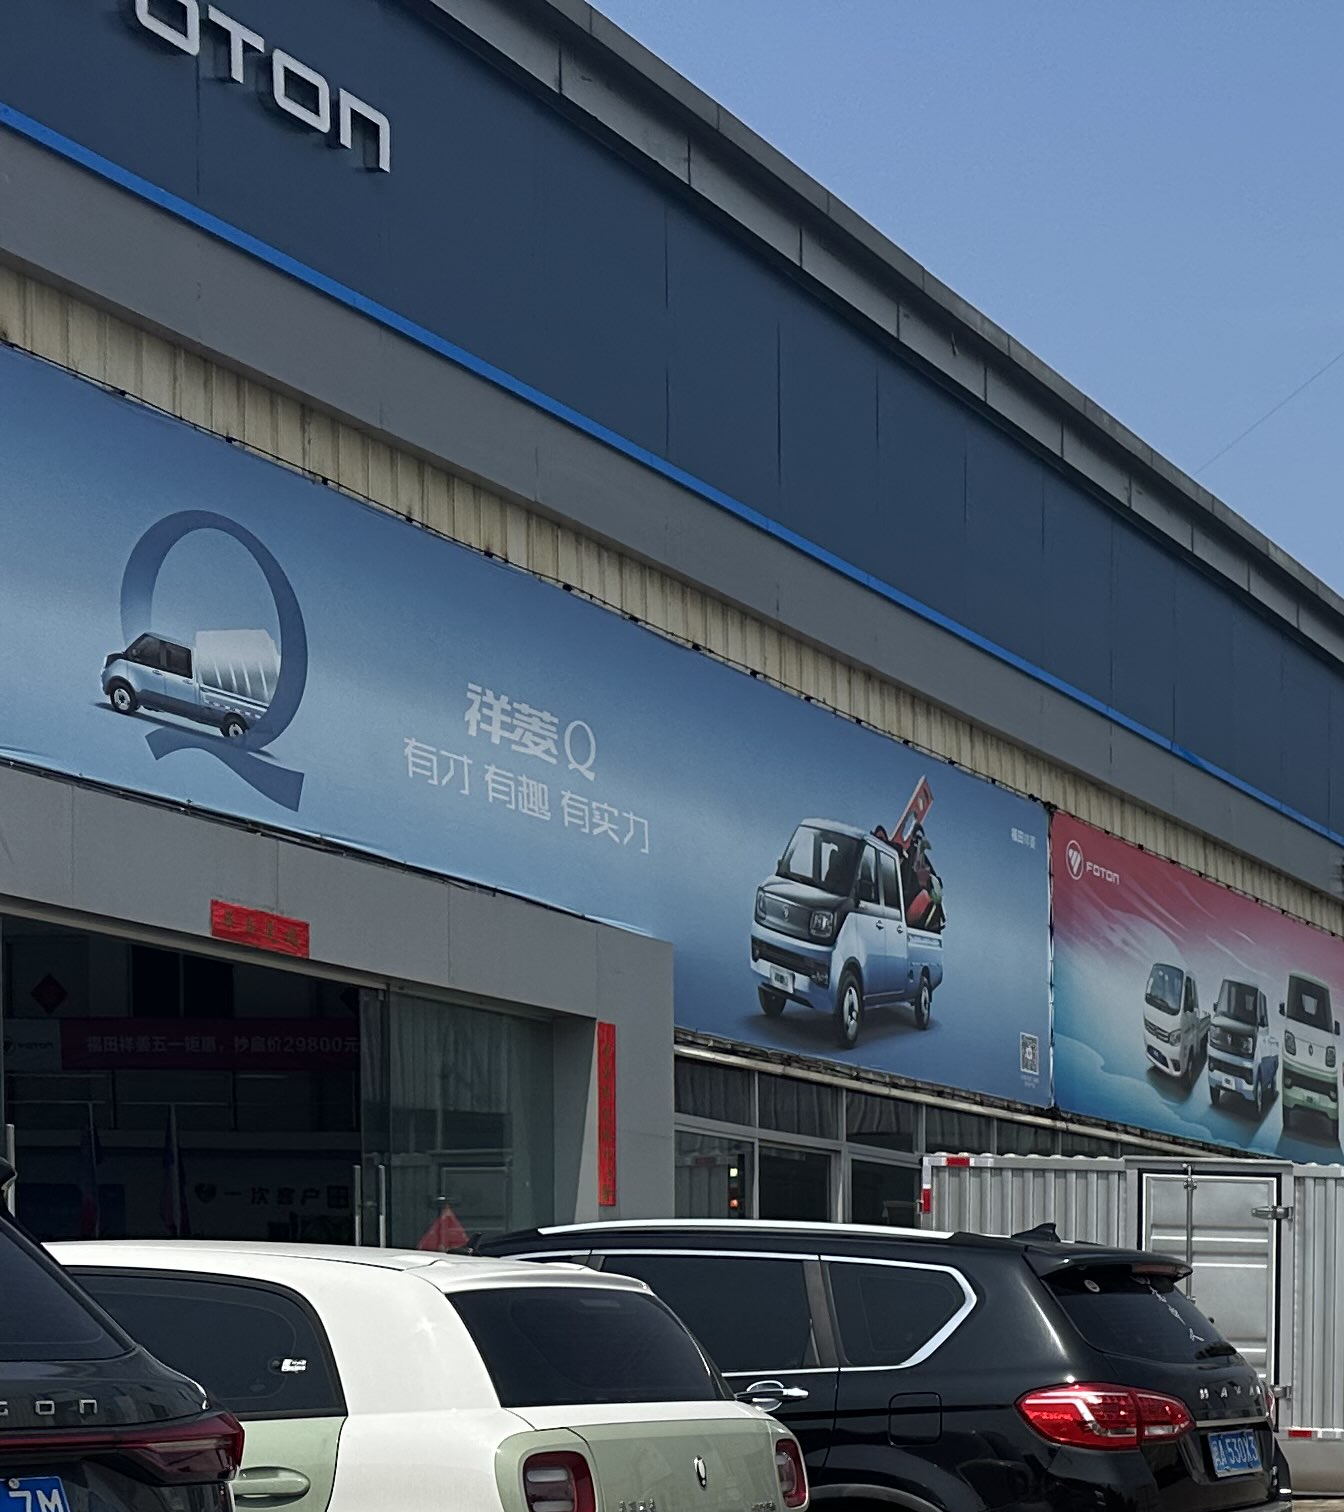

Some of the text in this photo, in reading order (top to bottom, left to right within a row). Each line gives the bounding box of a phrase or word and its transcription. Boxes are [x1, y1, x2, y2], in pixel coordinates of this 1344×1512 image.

[404, 738, 649, 853] 有才 有趣 有实力
[1085, 861, 1120, 885] FOTON
